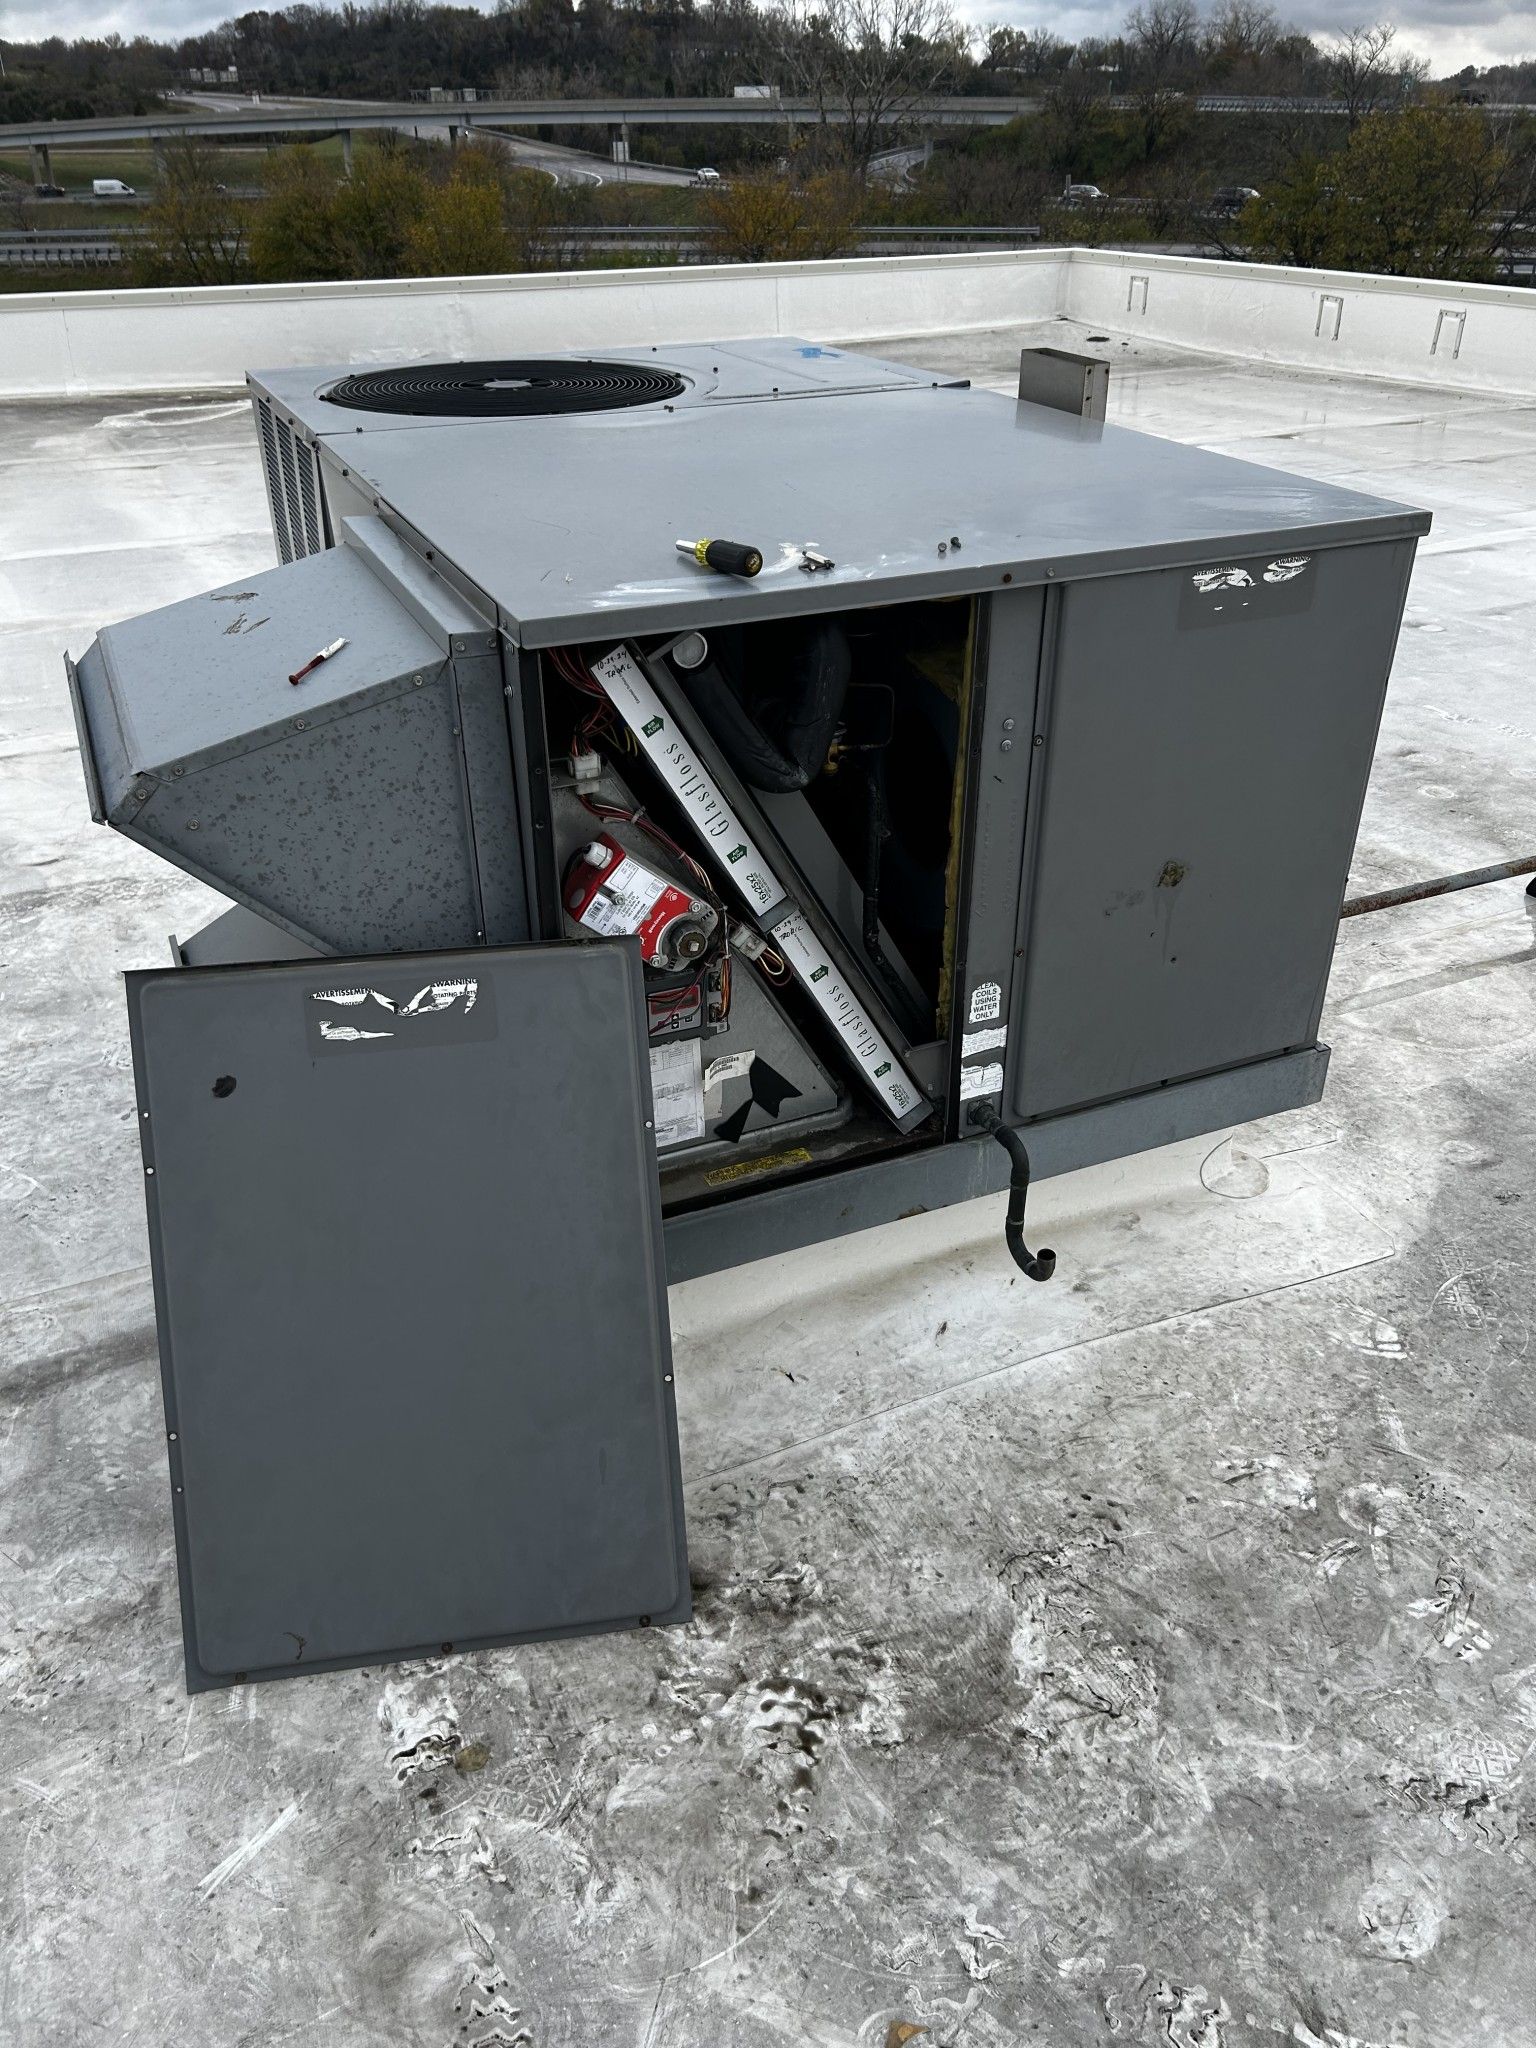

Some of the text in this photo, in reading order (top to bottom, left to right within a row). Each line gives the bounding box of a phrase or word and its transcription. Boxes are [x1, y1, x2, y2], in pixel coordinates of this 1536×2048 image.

[665, 743, 730, 837] Glasfloss
[745, 873, 769, 904] 16x25x2
[436, 978, 477, 988] WARNING
[431, 991, 458, 999] OTATING
[976, 987, 998, 999] COILS
[975, 995, 997, 1006] USING
[973, 1002, 998, 1013] WATER
[976, 1010, 994, 1020] ONLY
[828, 984, 879, 1058] Glasfloss
